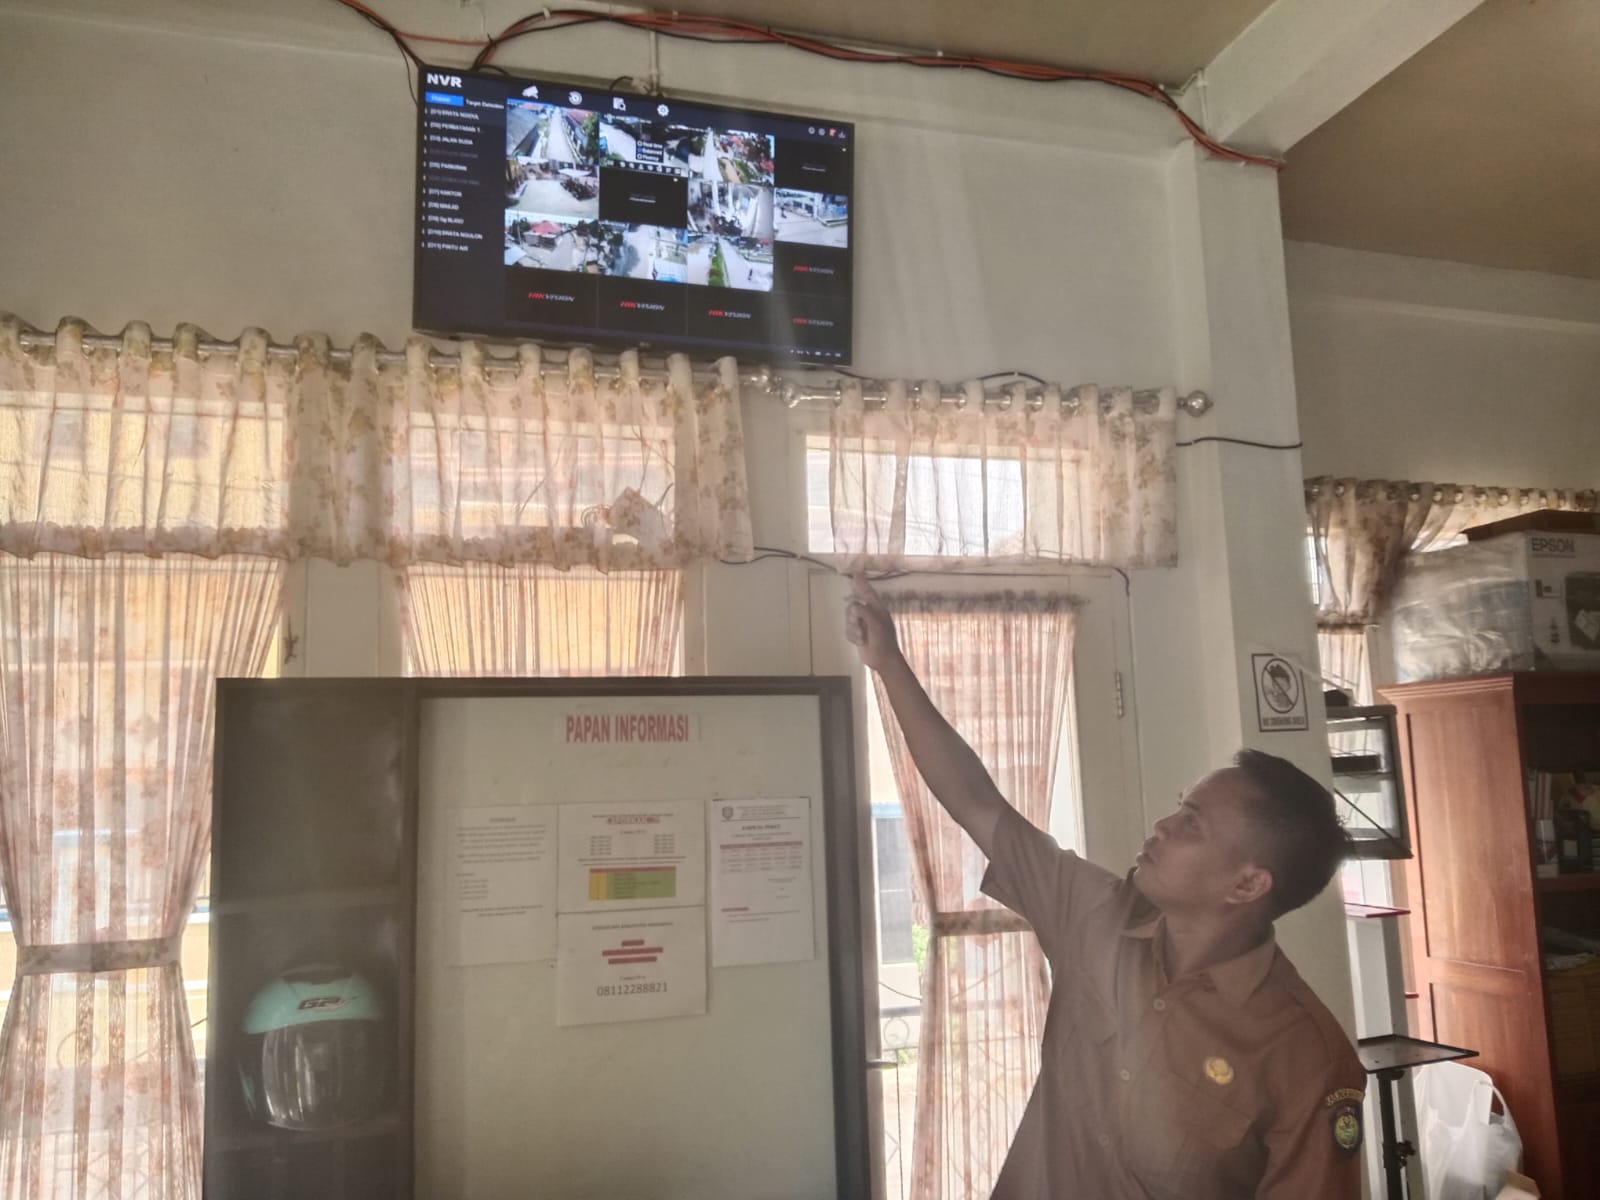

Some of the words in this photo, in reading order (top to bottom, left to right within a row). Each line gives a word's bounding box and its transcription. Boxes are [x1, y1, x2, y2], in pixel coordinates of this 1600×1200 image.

[427, 73, 463, 89] NVR
[1531, 537, 1575, 553] EPSON
[566, 714, 610, 742] PAPAN
[615, 714, 689, 742] INFORMASI
[596, 982, 668, 997] 08112288821
